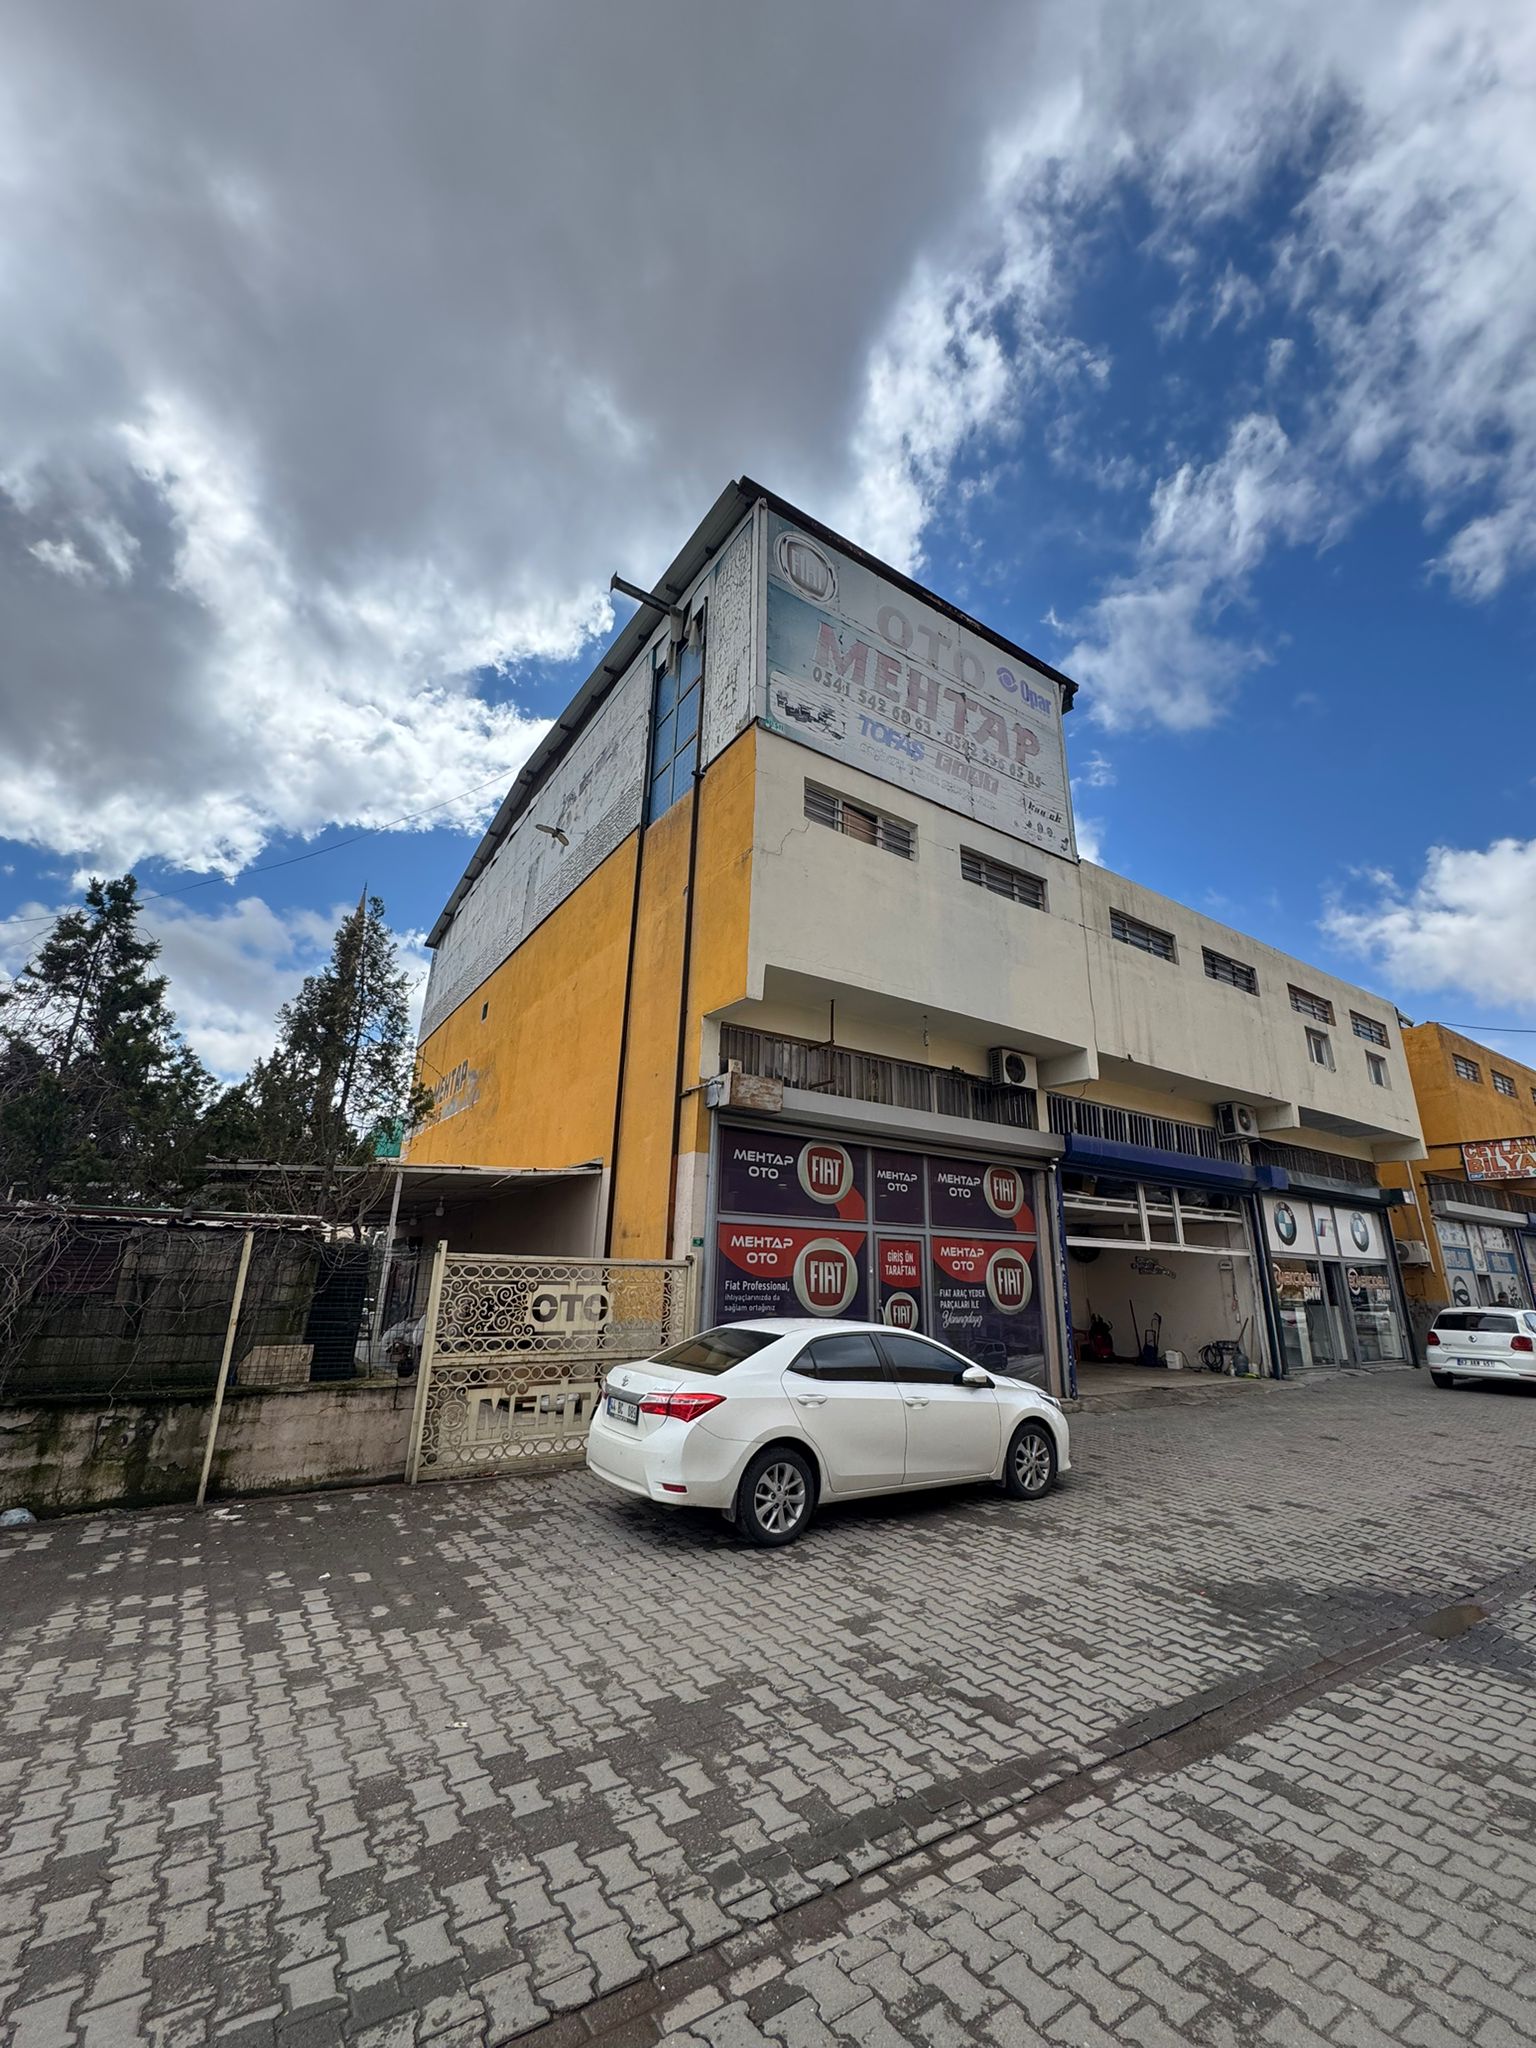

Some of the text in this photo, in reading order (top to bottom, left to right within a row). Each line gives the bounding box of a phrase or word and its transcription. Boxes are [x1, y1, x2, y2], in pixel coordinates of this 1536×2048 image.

[876, 605, 986, 690] OTO
[813, 622, 1041, 765] MEHTAP
[1019, 679, 1052, 715] Opar
[858, 690, 886, 713] 542
[1463, 1138, 1536, 1158] CEYLAN
[733, 1148, 794, 1166] MEHTAP
[748, 1165, 779, 1180] OTO
[812, 1155, 842, 1186] FIAT
[876, 1169, 918, 1182] MEHTAP
[937, 1172, 981, 1186] MEHTAP
[887, 1182, 909, 1193] OTO
[949, 1187, 971, 1198] OTO
[993, 1176, 1015, 1203] FIAT
[731, 1235, 793, 1249] MEHTAP
[746, 1252, 778, 1265] OTO
[940, 1247, 984, 1258] MEHTAP
[885, 1264, 917, 1276] TARAFTAN
[952, 1260, 975, 1271] OTO
[810, 1260, 844, 1294] FIAT
[997, 1267, 1022, 1296] FIAT
[725, 1280, 790, 1292] Fiat Professional,
[939, 1288, 986, 1299] FIAT ARAÇ YEDEK
[531, 1294, 609, 1323] OTO
[724, 1304, 748, 1312] sağlam
[940, 1300, 970, 1310] PARÇALARI
[892, 1305, 911, 1324] FIAT
[477, 1391, 599, 1431] MEHT
